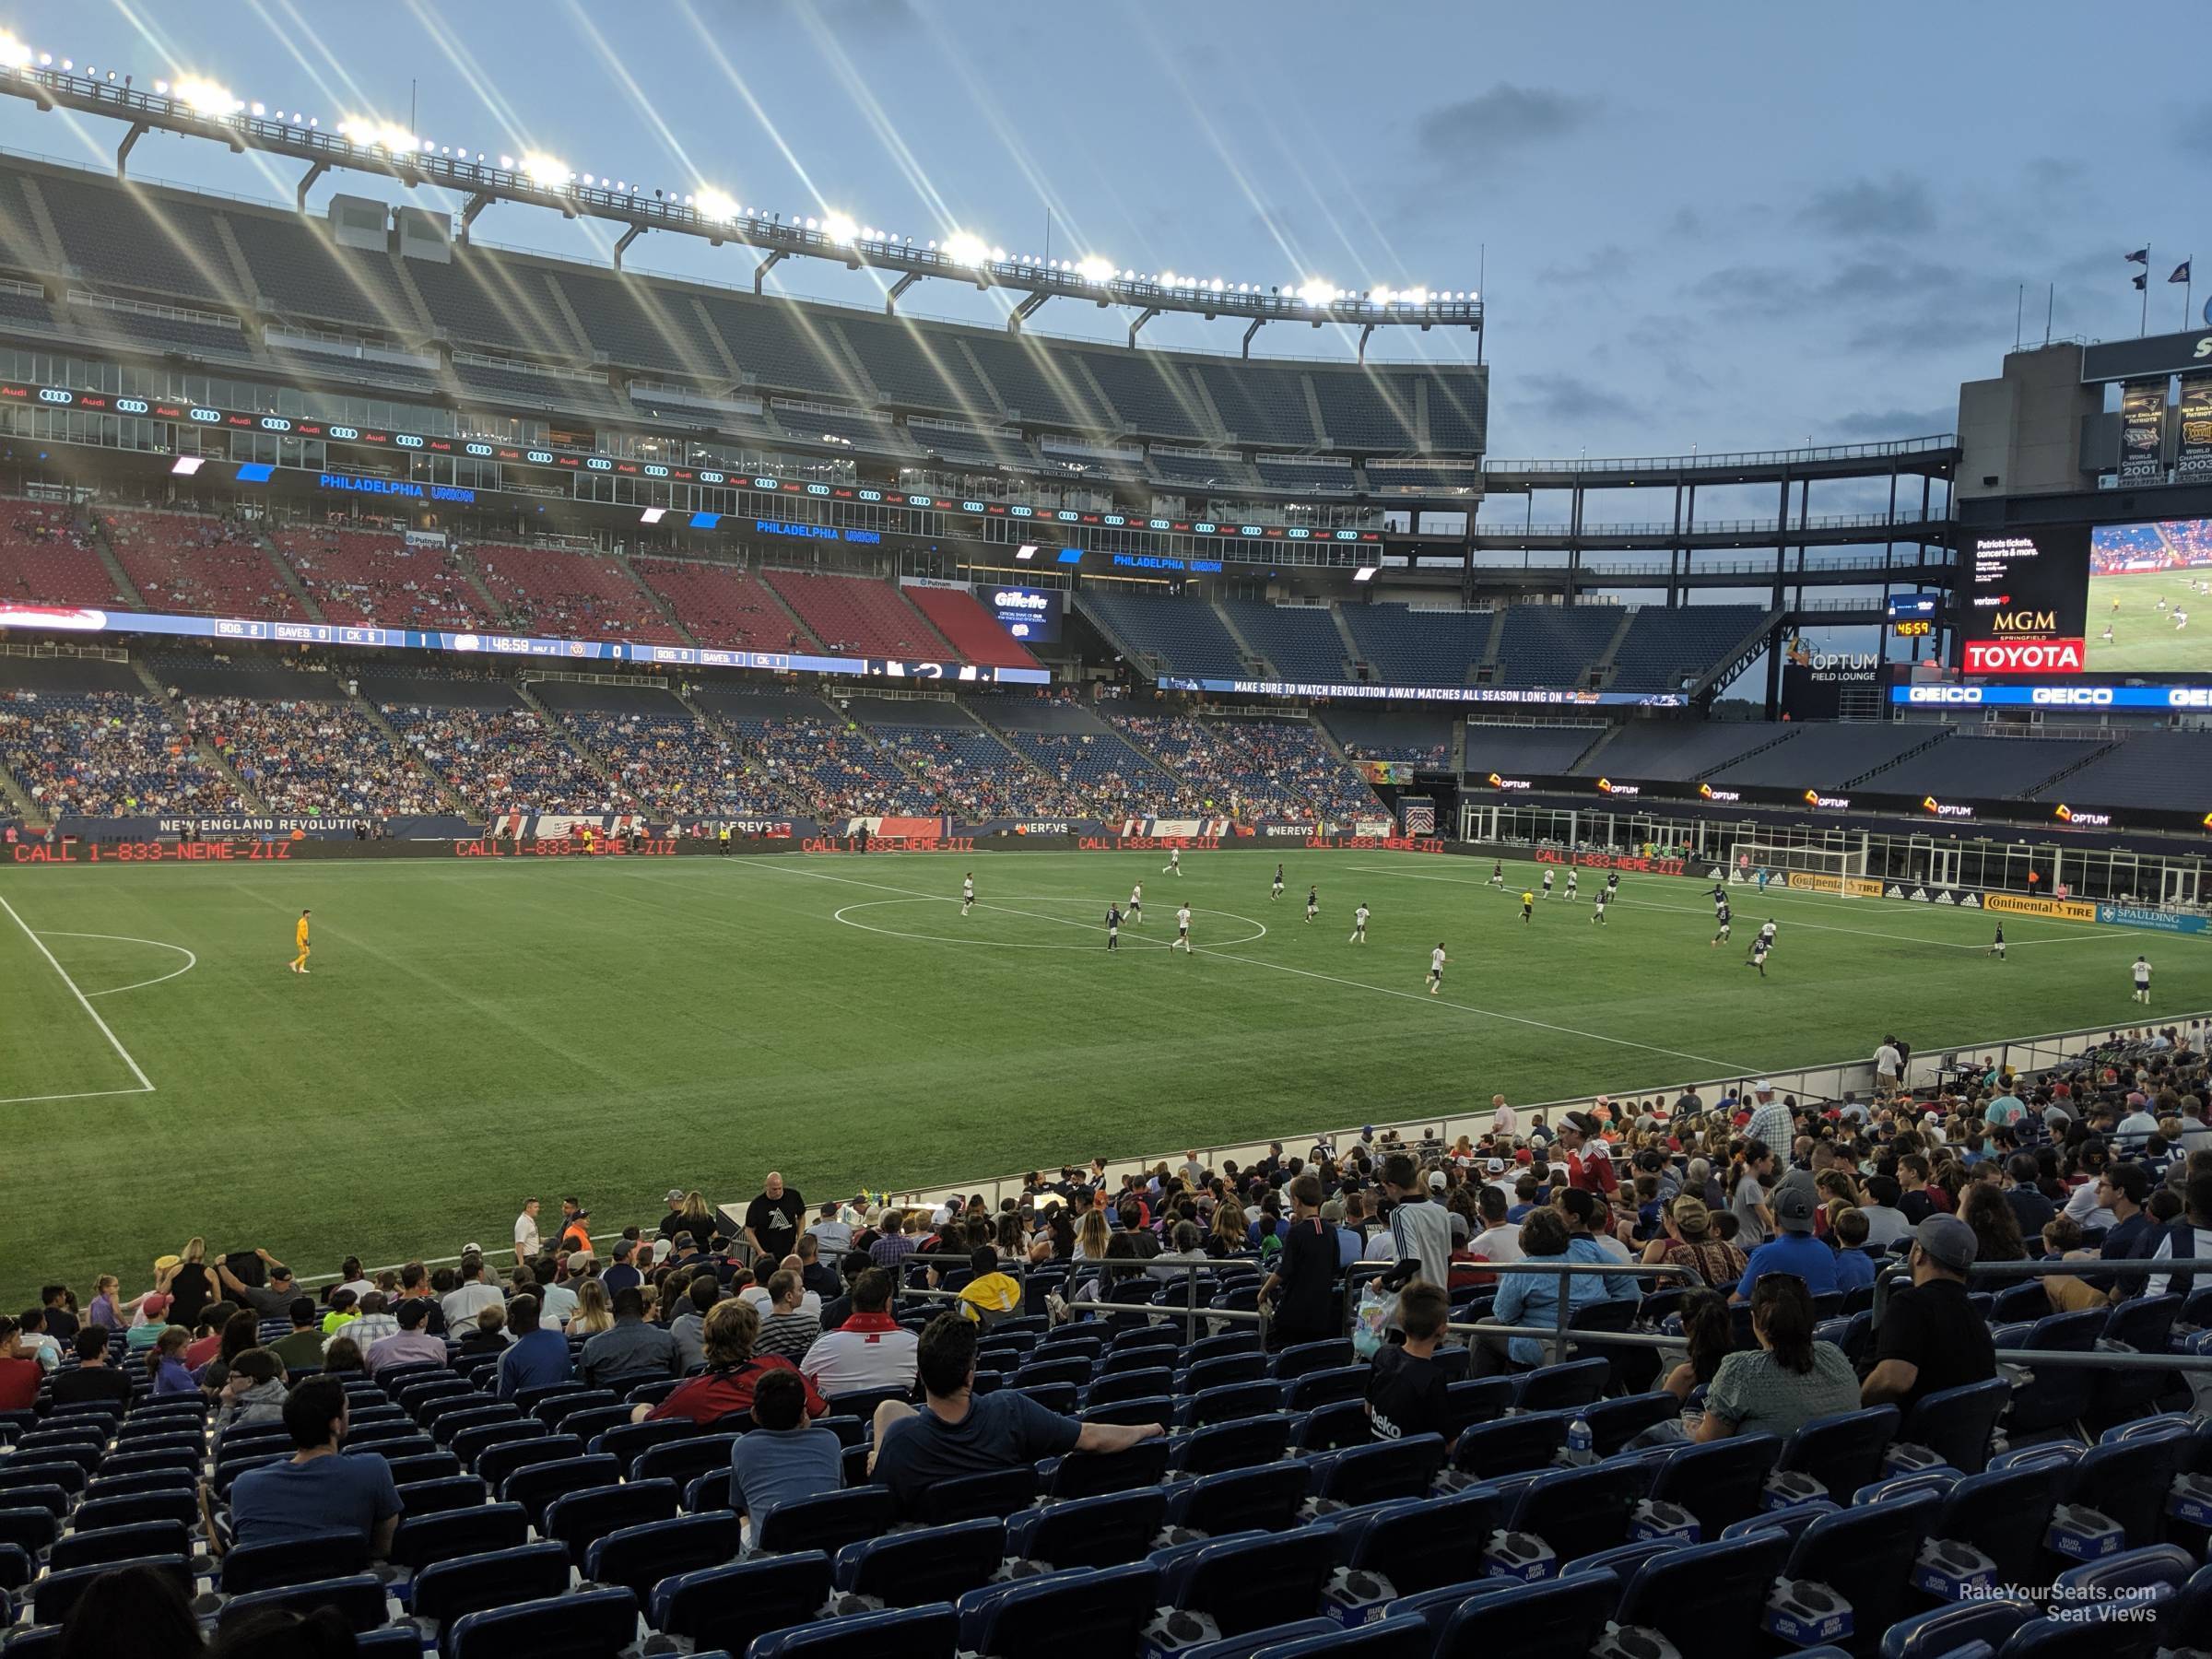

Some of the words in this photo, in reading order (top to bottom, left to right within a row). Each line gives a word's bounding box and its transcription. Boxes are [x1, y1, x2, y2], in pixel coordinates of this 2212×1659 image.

[1, 386, 28, 397] Audi
[79, 396, 105, 406] Audi
[155, 406, 180, 418] Audi
[229, 415, 252, 426] Audi
[298, 424, 322, 434] Audi
[365, 434, 386, 442] Audi
[430, 441, 451, 451] Audi
[500, 450, 519, 458] Audi
[559, 457, 580, 466] Audi
[2178, 460, 2212, 472] 2003
[618, 464, 636, 473] Audi
[2123, 465, 2156, 477] 2001
[674, 471, 692, 479] Audi
[729, 477, 747, 486] Audi
[320, 474, 423, 497] PHILADELPHIA
[430, 486, 476, 502] UNION
[782, 484, 801, 492] Audi
[834, 489, 853, 498] Audi
[887, 494, 903, 502] Audi
[935, 500, 952, 510] Audi
[989, 506, 1004, 514] Audi
[1082, 515, 1099, 524] Audi
[1129, 519, 1144, 527] Audi
[756, 520, 840, 540] PHILADELPHIA
[844, 530, 880, 544] UNION
[1173, 523, 1189, 531] Audi
[1218, 526, 1236, 535] Audi
[1313, 531, 1331, 539] Audi
[1362, 533, 1379, 541] Audi
[415, 537, 444, 546] Putnam
[1977, 539, 2006, 549] Patriots
[1976, 548, 2008, 559] concerts
[2017, 547, 2039, 556] more.
[1112, 553, 1185, 571] PHILADELPHIA
[1189, 560, 1223, 573] UNION
[994, 592, 1048, 609] Gillette
[1993, 611, 2056, 630] MGM
[219, 622, 243, 634] SOG:
[250, 625, 258, 635] 2
[278, 627, 312, 638] SAVES:
[318, 629, 326, 639] 0
[1898, 622, 1928, 635] 46:59
[347, 630, 362, 641] CK:
[420, 633, 426, 647] 1
[492, 637, 529, 652] 46:59
[612, 645, 622, 658] 0
[657, 649, 677, 660] SOG:
[681, 651, 688, 660] 0
[1969, 646, 2079, 667] TOYOTA
[703, 653, 731, 664] SAVES:
[735, 653, 739, 664] 1
[775, 656, 781, 665] 1
[1812, 653, 1878, 670] OPTUM
[1811, 672, 1836, 681] FIELD
[1837, 672, 1877, 681] LOUNGE
[1234, 681, 1258, 692] MAKE
[1259, 682, 1283, 693] SURE
[1285, 683, 1295, 694] TO
[1298, 684, 1328, 695] WATCH
[1330, 685, 1386, 698] REVOLUTION
[1388, 688, 1416, 699] AWAY
[1418, 688, 1460, 700] MATCHES
[1462, 689, 1479, 700] ALL
[1482, 690, 1519, 701] SEASON
[1522, 691, 1547, 702] LONG
[1548, 691, 1562, 702] ON
[1909, 687, 1983, 702] GEICO
[2032, 688, 2113, 704] GEICO
[1501, 780, 1530, 789] OPTUM
[1610, 785, 1639, 794] OPTUM
[1712, 791, 1739, 801] OPTUM
[1818, 798, 1849, 808] OPTUM
[1937, 805, 1971, 816] OPTUM
[160, 819, 195, 830] NEW
[201, 818, 274, 831] ENGLAND
[279, 818, 371, 830] REVOLUTION
[2070, 813, 2109, 826] OPTUM
[455, 840, 505, 856] CALL
[801, 838, 841, 853] CALL
[1078, 836, 1110, 851] CALL
[1116, 836, 1220, 851] 1-833-NEME-ZIZ
[1305, 836, 1334, 850] CALL
[1337, 836, 1444, 853] 1-833-NEME-ZIZ
[14, 843, 77, 863] CALL
[89, 842, 291, 863] 1-833-NEME-ZIZ
[1534, 849, 1565, 865] CALL
[1571, 852, 1685, 877] 1-833-NEME-ZIZ
[1857, 883, 1881, 893] TIRE
[1988, 895, 2053, 913] Continental
[2065, 906, 2092, 917] TIRE
[2117, 908, 2180, 924] SPAULDING
[1324, 1147, 1336, 1161] 14
[1371, 1403, 1402, 1439] beko
[2180, 1509, 2203, 1517] LIGHT
[2061, 1536, 2079, 1545] BUD
[2058, 1541, 2082, 1552] LIGHT
[2100, 1542, 2117, 1554] LIGHT
[1491, 1565, 1505, 1573] BUD
[1528, 1563, 1543, 1573] BUD
[1525, 1569, 1546, 1581] LIGHT
[1928, 1575, 1947, 1585] BUD
[1925, 1581, 1948, 1593] LIGHT
[1327, 1610, 1344, 1622] LIGHT
[1329, 1606, 1343, 1616] BUD
[1367, 1606, 1382, 1617] BUD
[1779, 1618, 1796, 1630] BUD
[1824, 1617, 1841, 1630] BUD
[1776, 1623, 1799, 1636] LIGHT
[1820, 1623, 1841, 1637] LIGHT
